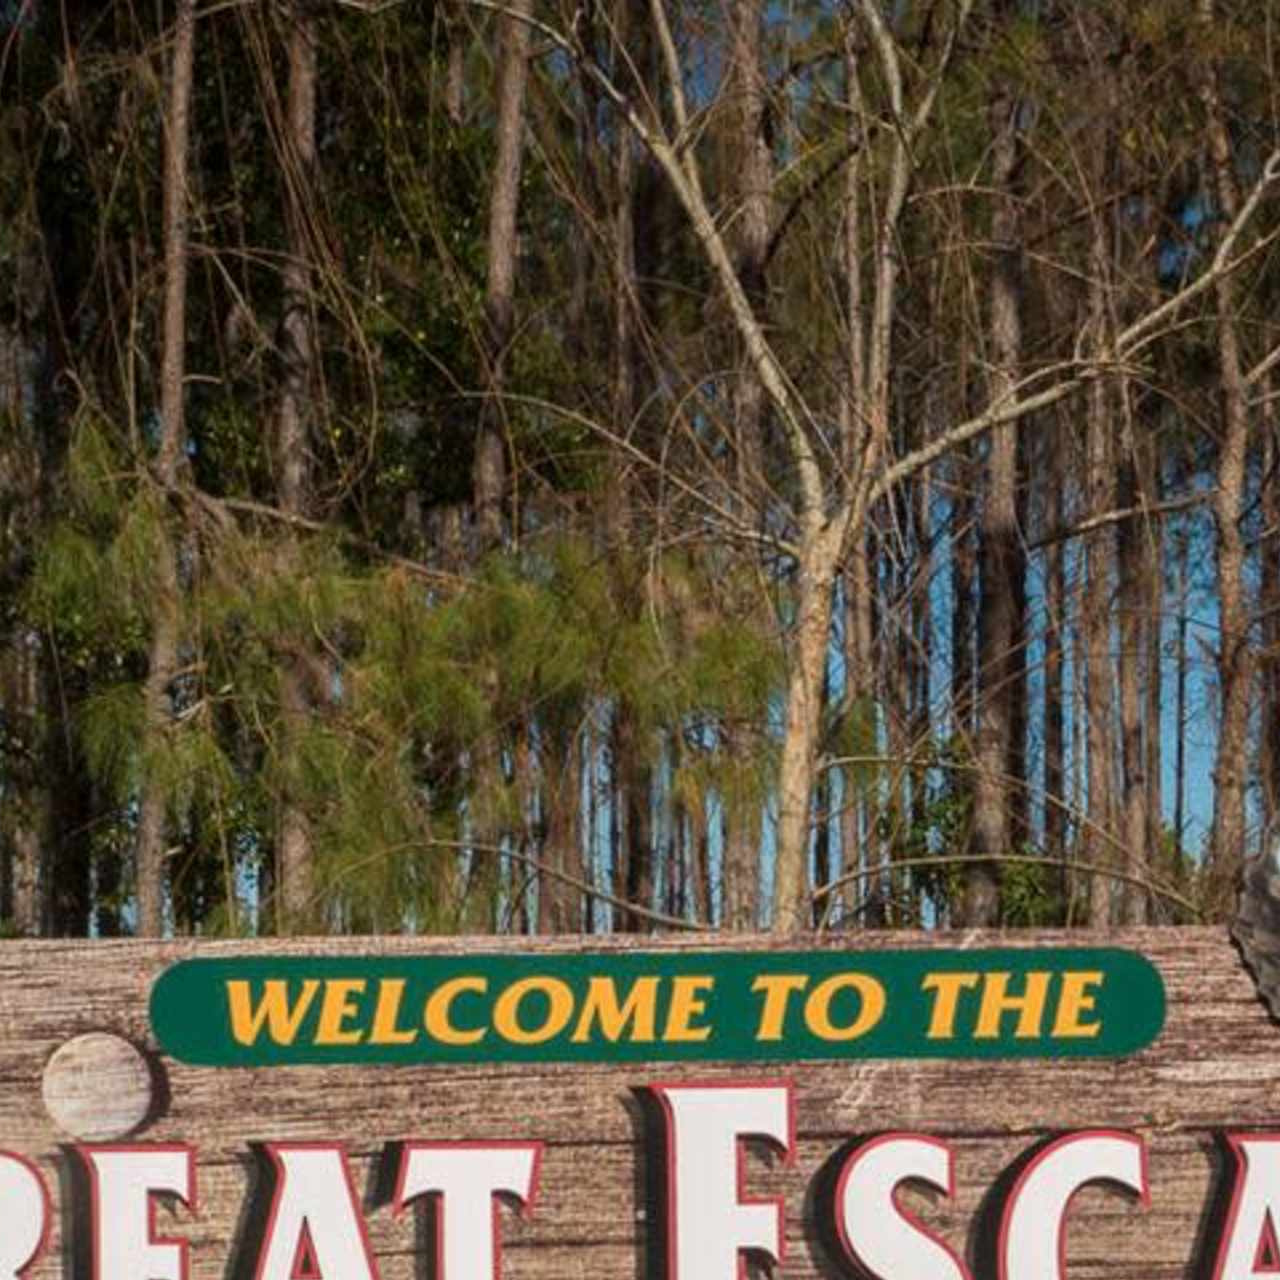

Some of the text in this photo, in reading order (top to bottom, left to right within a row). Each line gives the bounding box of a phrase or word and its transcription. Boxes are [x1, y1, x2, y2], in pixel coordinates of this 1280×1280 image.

[225, 969, 1103, 1047] WELCOME TO THE
